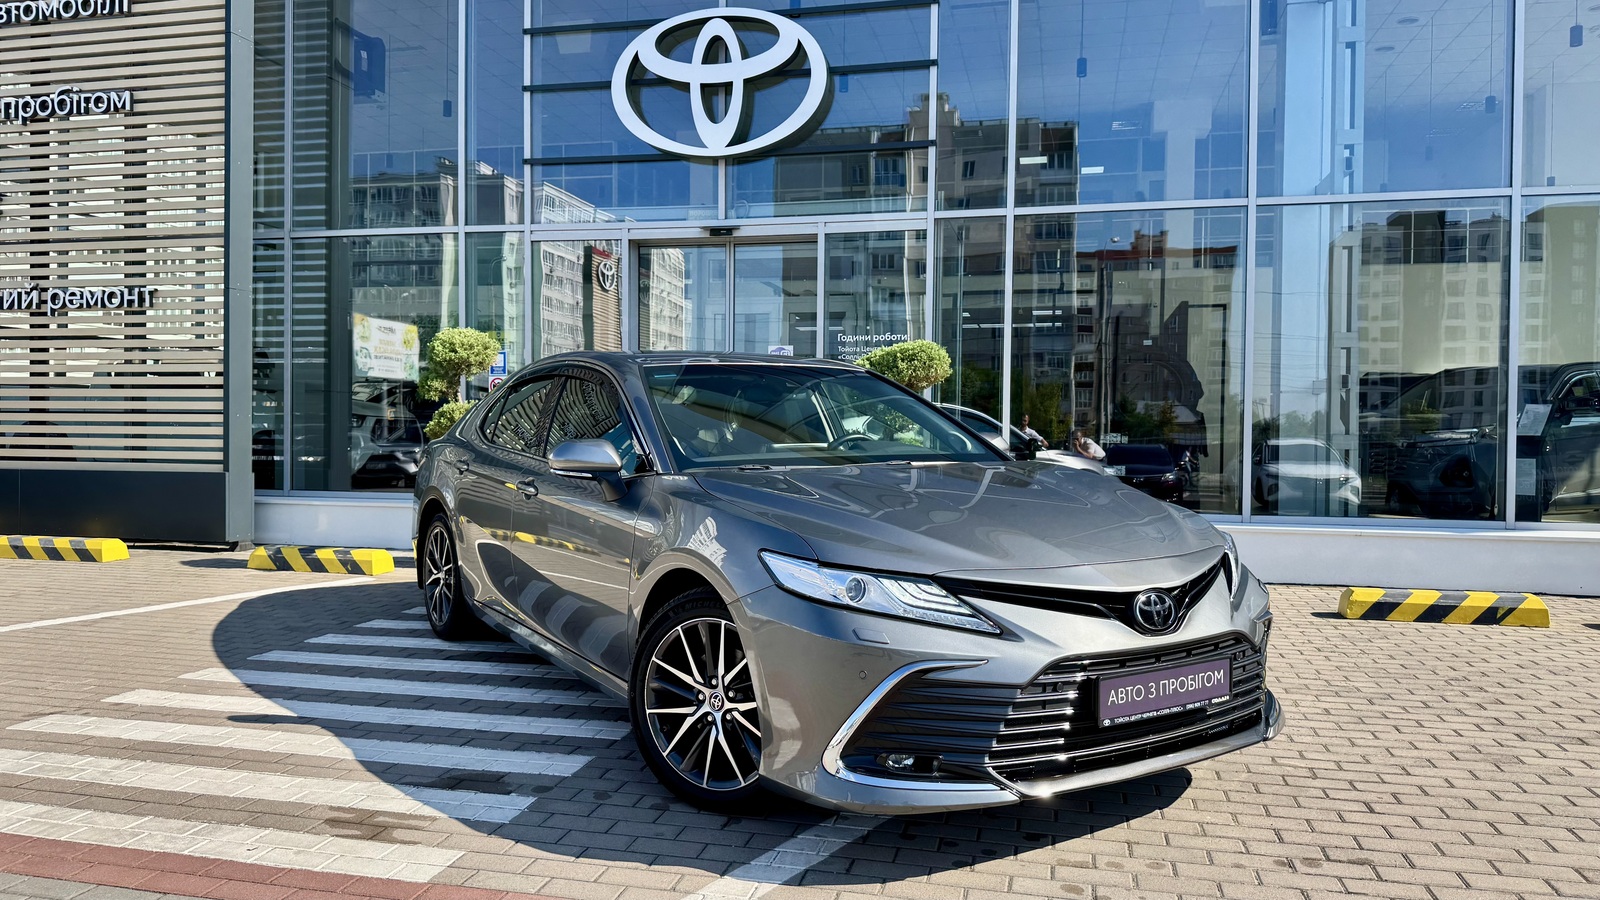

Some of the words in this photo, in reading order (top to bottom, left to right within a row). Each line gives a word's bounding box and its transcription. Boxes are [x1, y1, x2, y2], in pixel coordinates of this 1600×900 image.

[1, 86, 131, 125] пробігом
[47, 287, 156, 317] ремонт
[837, 333, 871, 342] Години
[1108, 684, 1145, 705] АВТО
[1160, 669, 1224, 696] ПРОБІГОМ
